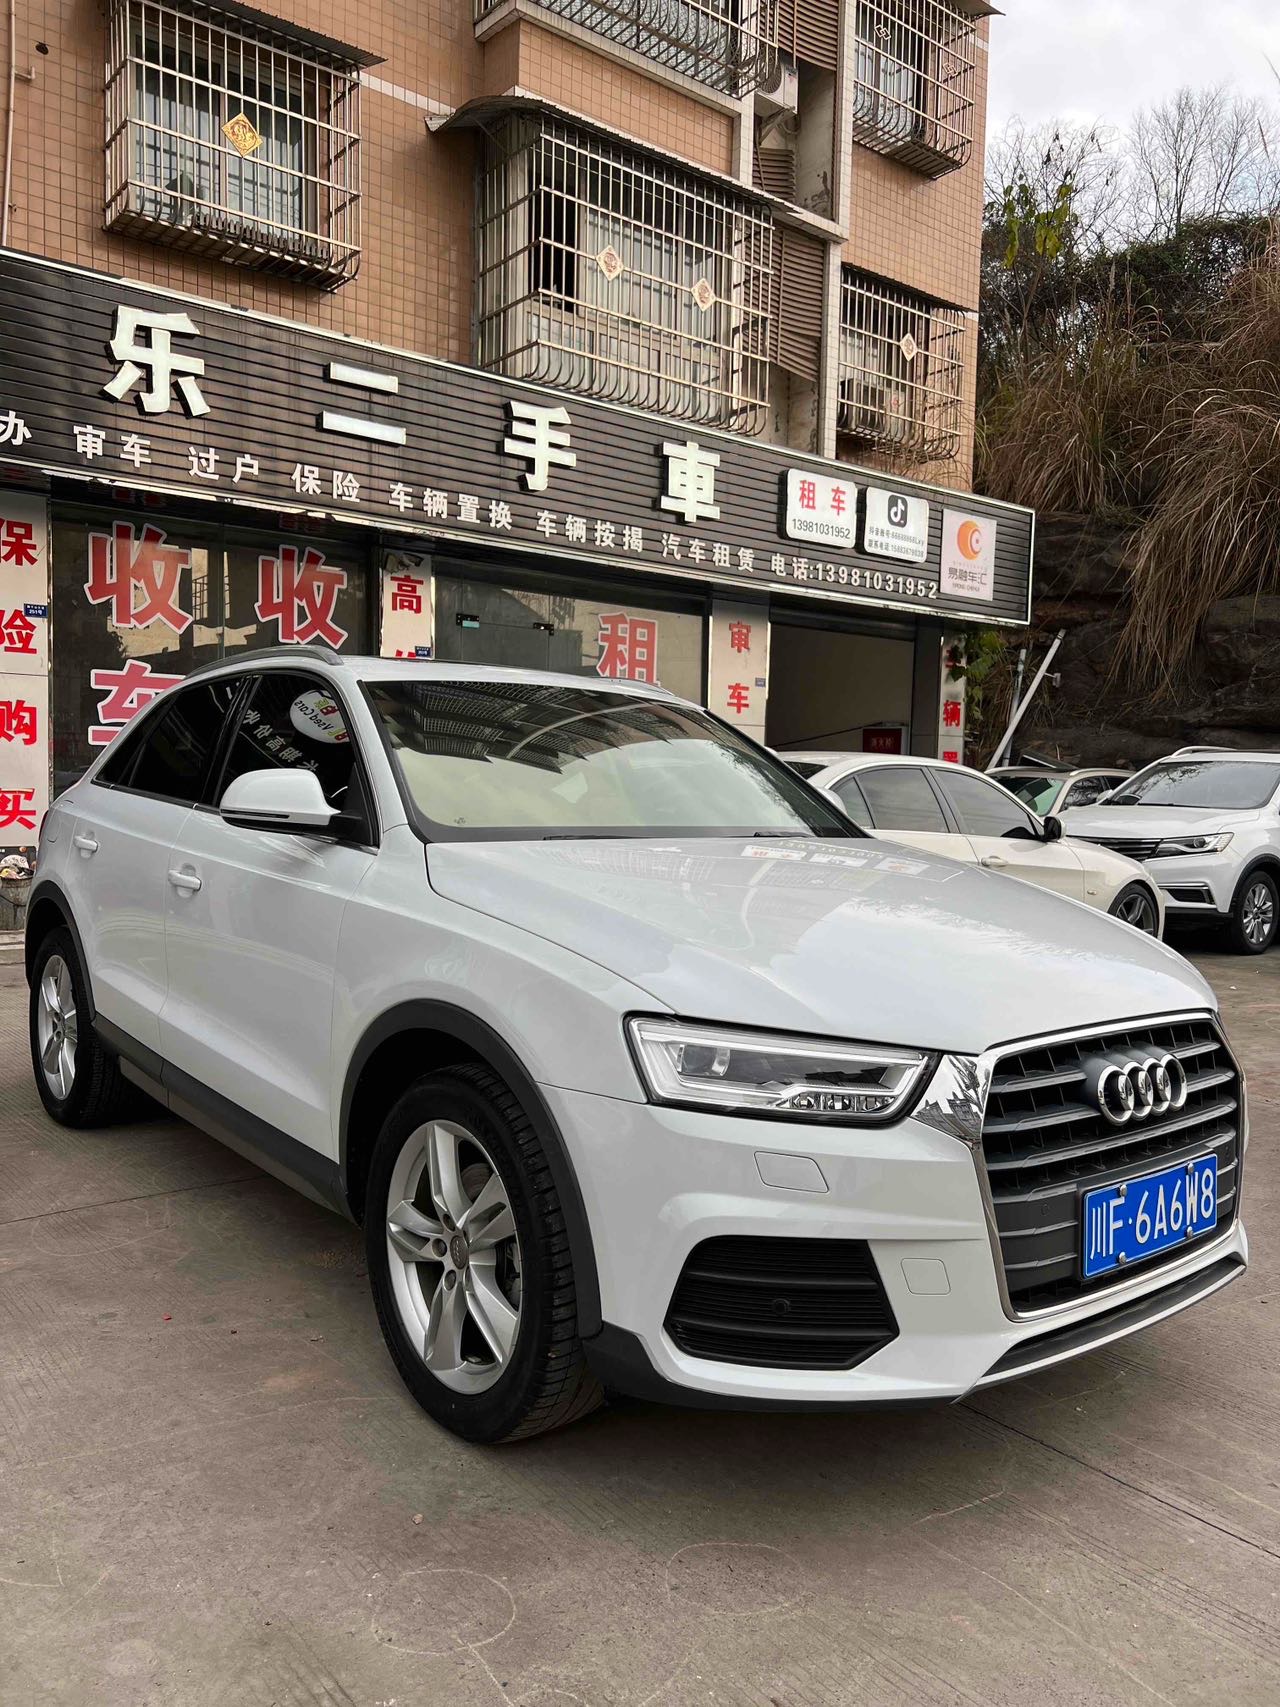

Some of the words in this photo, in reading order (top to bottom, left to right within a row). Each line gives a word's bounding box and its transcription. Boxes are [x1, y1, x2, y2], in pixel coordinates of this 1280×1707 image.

[73, 424, 152, 467] 审车
[188, 447, 259, 483] 过户
[291, 463, 361, 503] 保险
[389, 482, 513, 531] 车辆置换
[536, 510, 643, 553] 车辆按揭
[661, 533, 754, 573] 汽车租赁
[799, 480, 846, 516] 租车
[792, 518, 851, 540] 13981031952
